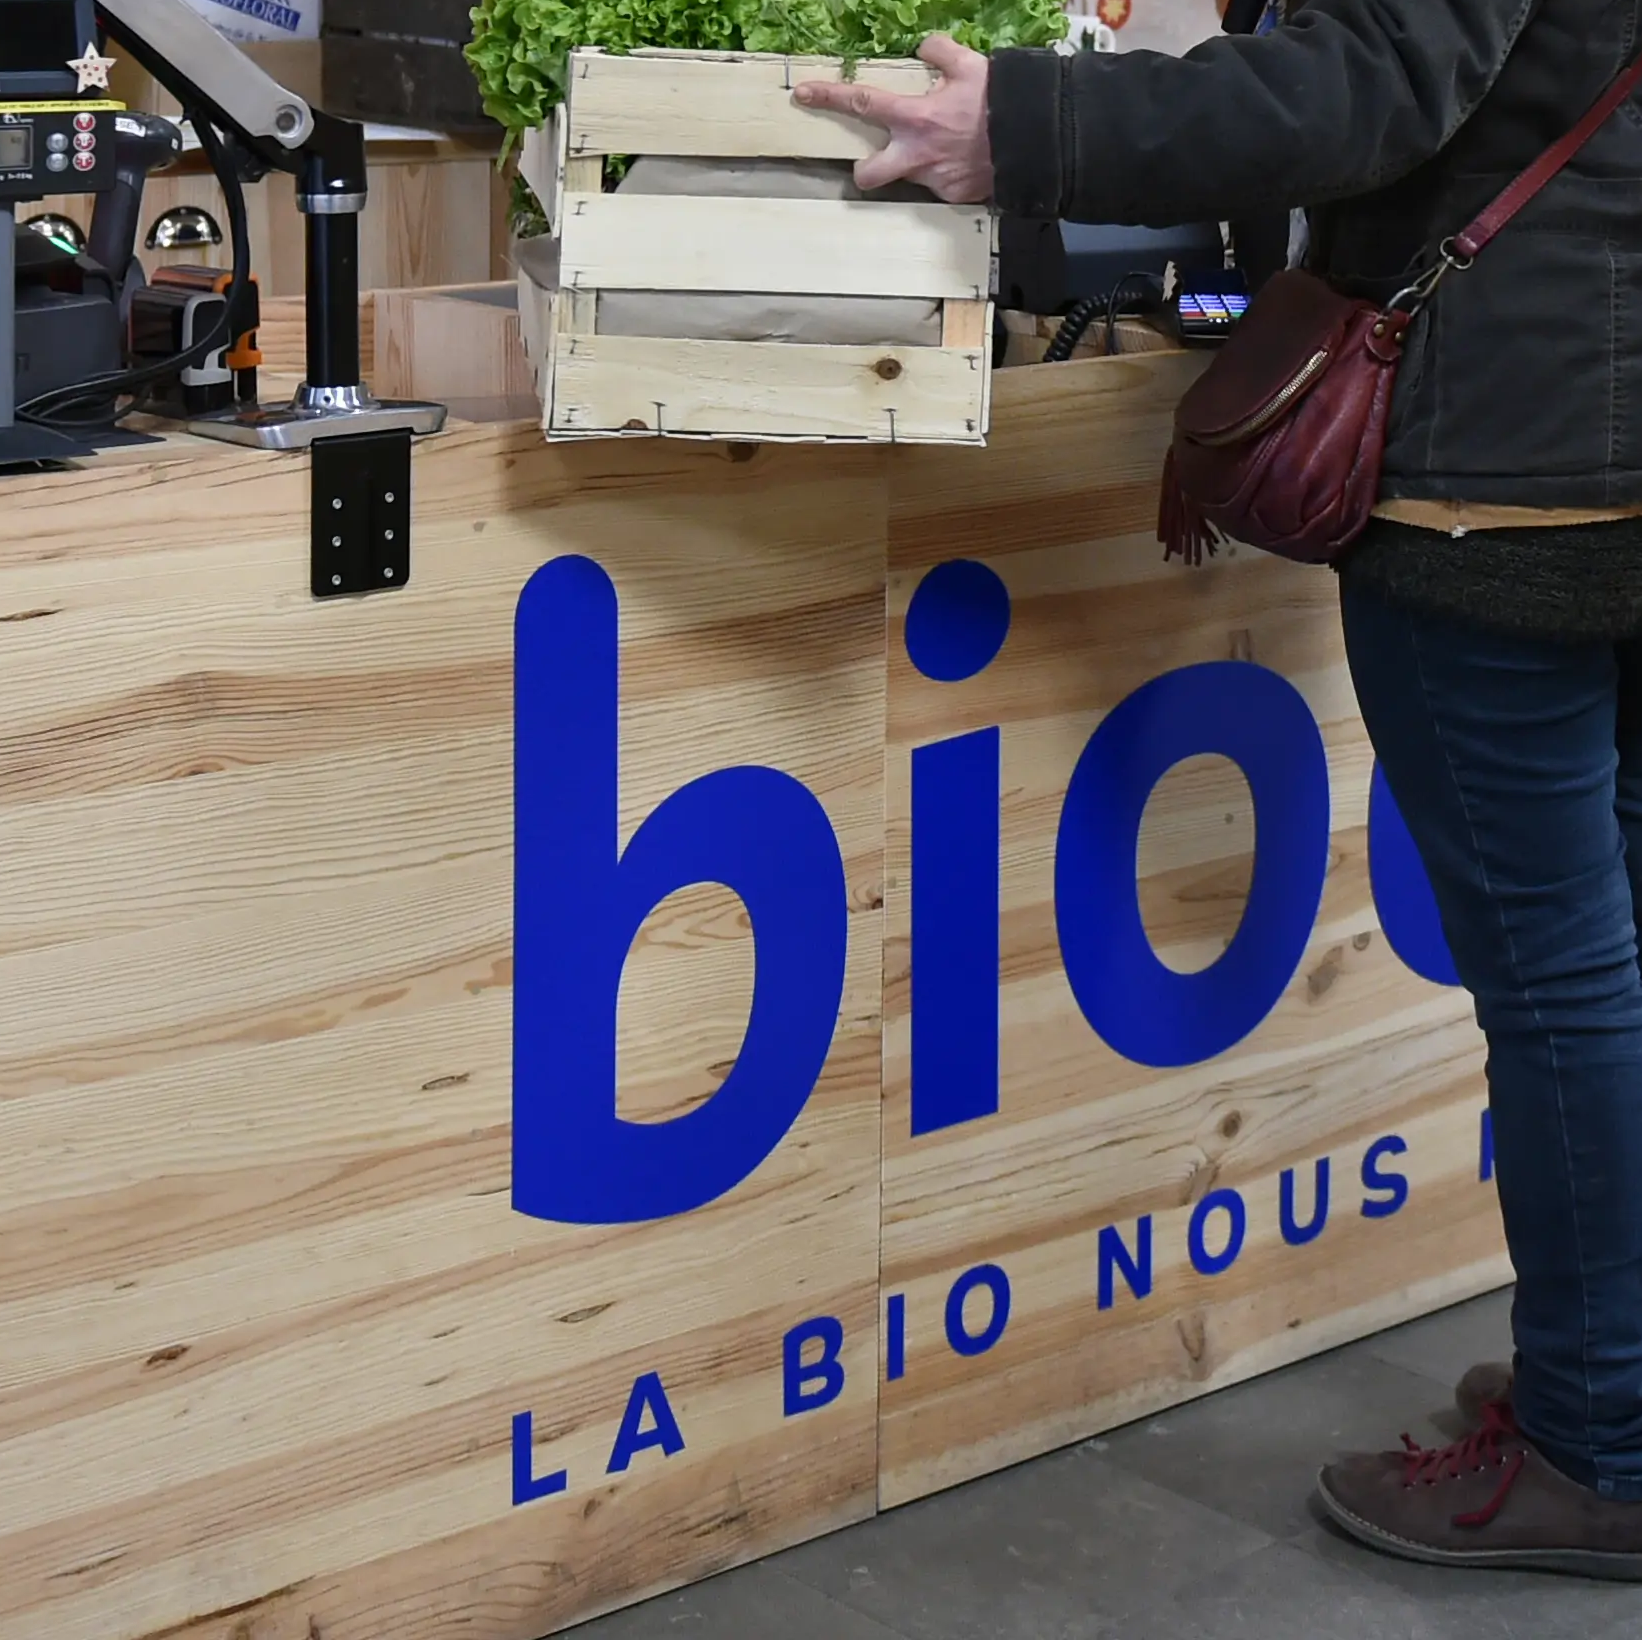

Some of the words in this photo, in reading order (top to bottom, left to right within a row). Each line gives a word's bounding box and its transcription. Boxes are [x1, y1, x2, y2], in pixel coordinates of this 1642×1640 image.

[512, 1372, 685, 1506] LA
[783, 1264, 1013, 1417] BIO
[1098, 1133, 1410, 1310] NOUS
